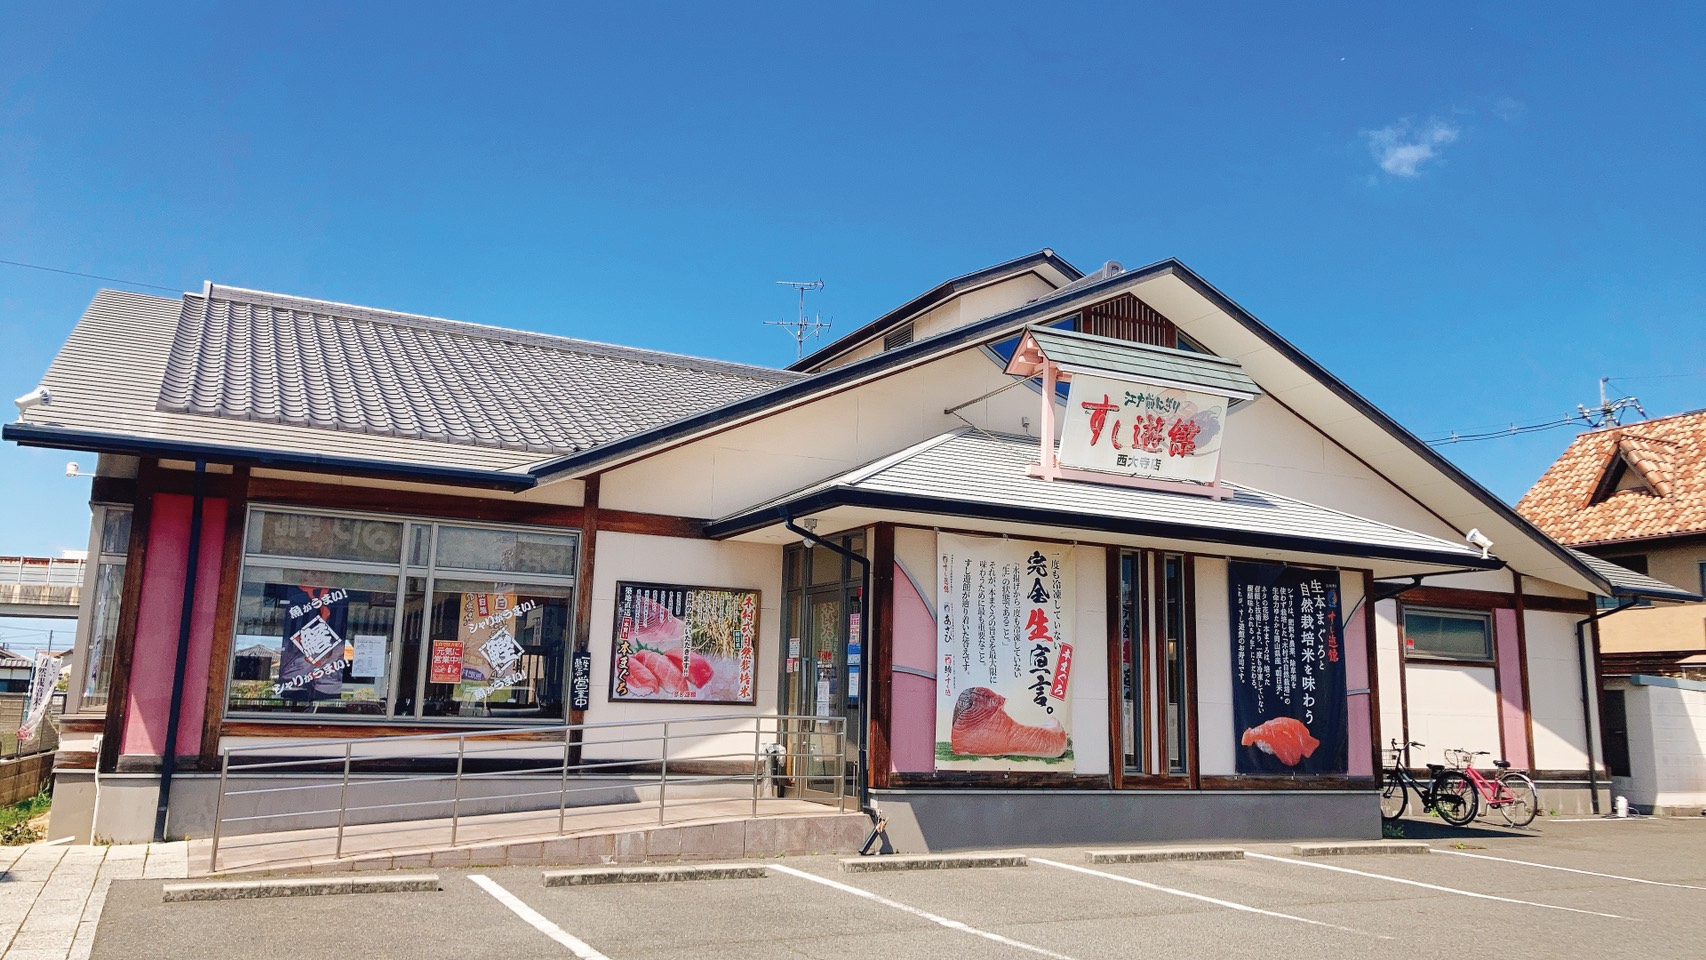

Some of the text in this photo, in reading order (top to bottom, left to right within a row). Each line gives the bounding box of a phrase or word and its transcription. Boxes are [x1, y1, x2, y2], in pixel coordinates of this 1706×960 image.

[1081, 394, 1200, 458] すし遊館
[1124, 391, 1180, 413] 江戸前にぎり
[1117, 454, 1161, 471] 西大寺店
[1051, 552, 1062, 650] 一度も冷凍していない
[1310, 579, 1327, 670] 生本まぐろと
[437, 646, 460, 656] 元気に
[616, 641, 633, 697] 本まぐろ
[739, 595, 755, 699] 木村式自然栽培米
[1053, 648, 1072, 696] 本まぐろ
[1300, 582, 1316, 725] 自然栽培米を味わう
[573, 675, 590, 708] 営業中
